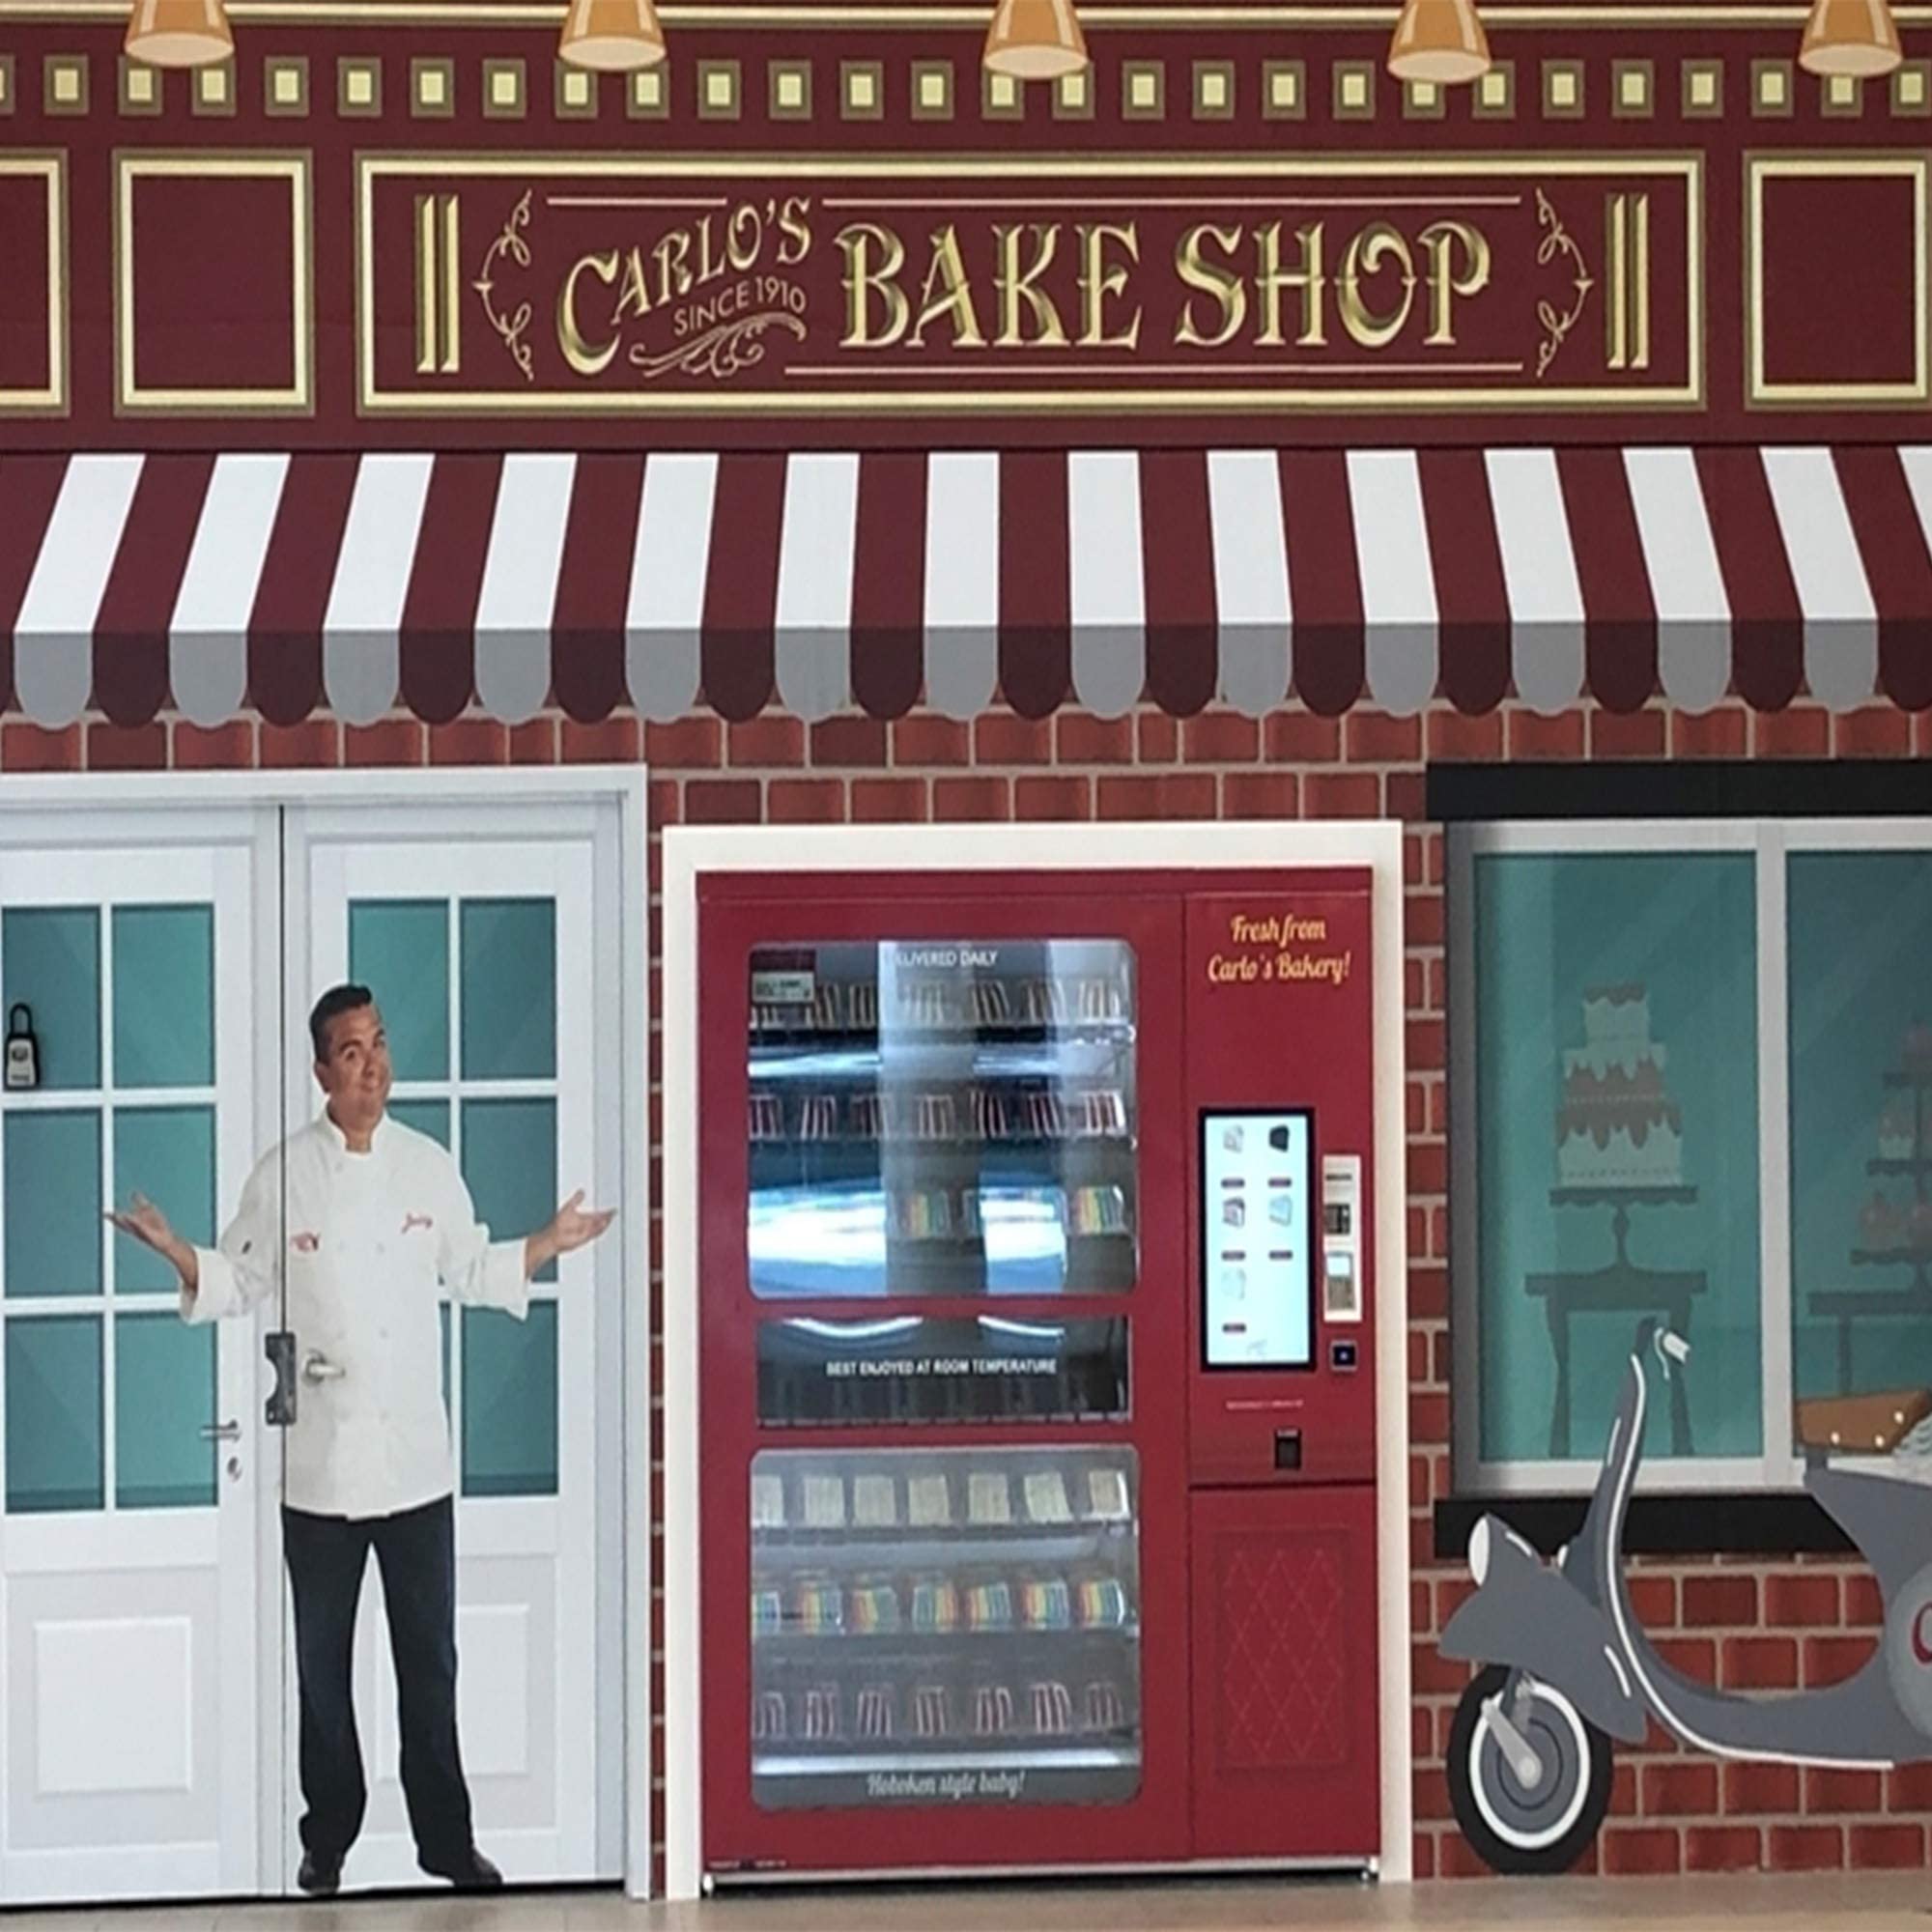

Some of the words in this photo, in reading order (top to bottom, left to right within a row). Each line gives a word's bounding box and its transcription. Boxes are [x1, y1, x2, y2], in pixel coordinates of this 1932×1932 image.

[557, 197, 811, 375] CARLO'S
[834, 221, 1142, 350] BAKE
[1174, 220, 1491, 349] SHOP
[674, 280, 750, 335] SINCE
[755, 276, 807, 313] 1910
[1231, 915, 1280, 943] Fresh
[1279, 914, 1326, 949] from
[960, 949, 998, 966] DAILY
[1208, 953, 1272, 982] Carlo's
[1275, 950, 1350, 985] Bakery!
[826, 1361, 857, 1377] BEST
[860, 1360, 914, 1377] ENJOYED
[917, 1359, 931, 1375] AT
[933, 1359, 969, 1375] ROOM
[972, 1358, 1057, 1375] TEMPERATURE
[867, 1772, 936, 1797] Hoboken
[979, 1770, 1025, 1800] baby!
